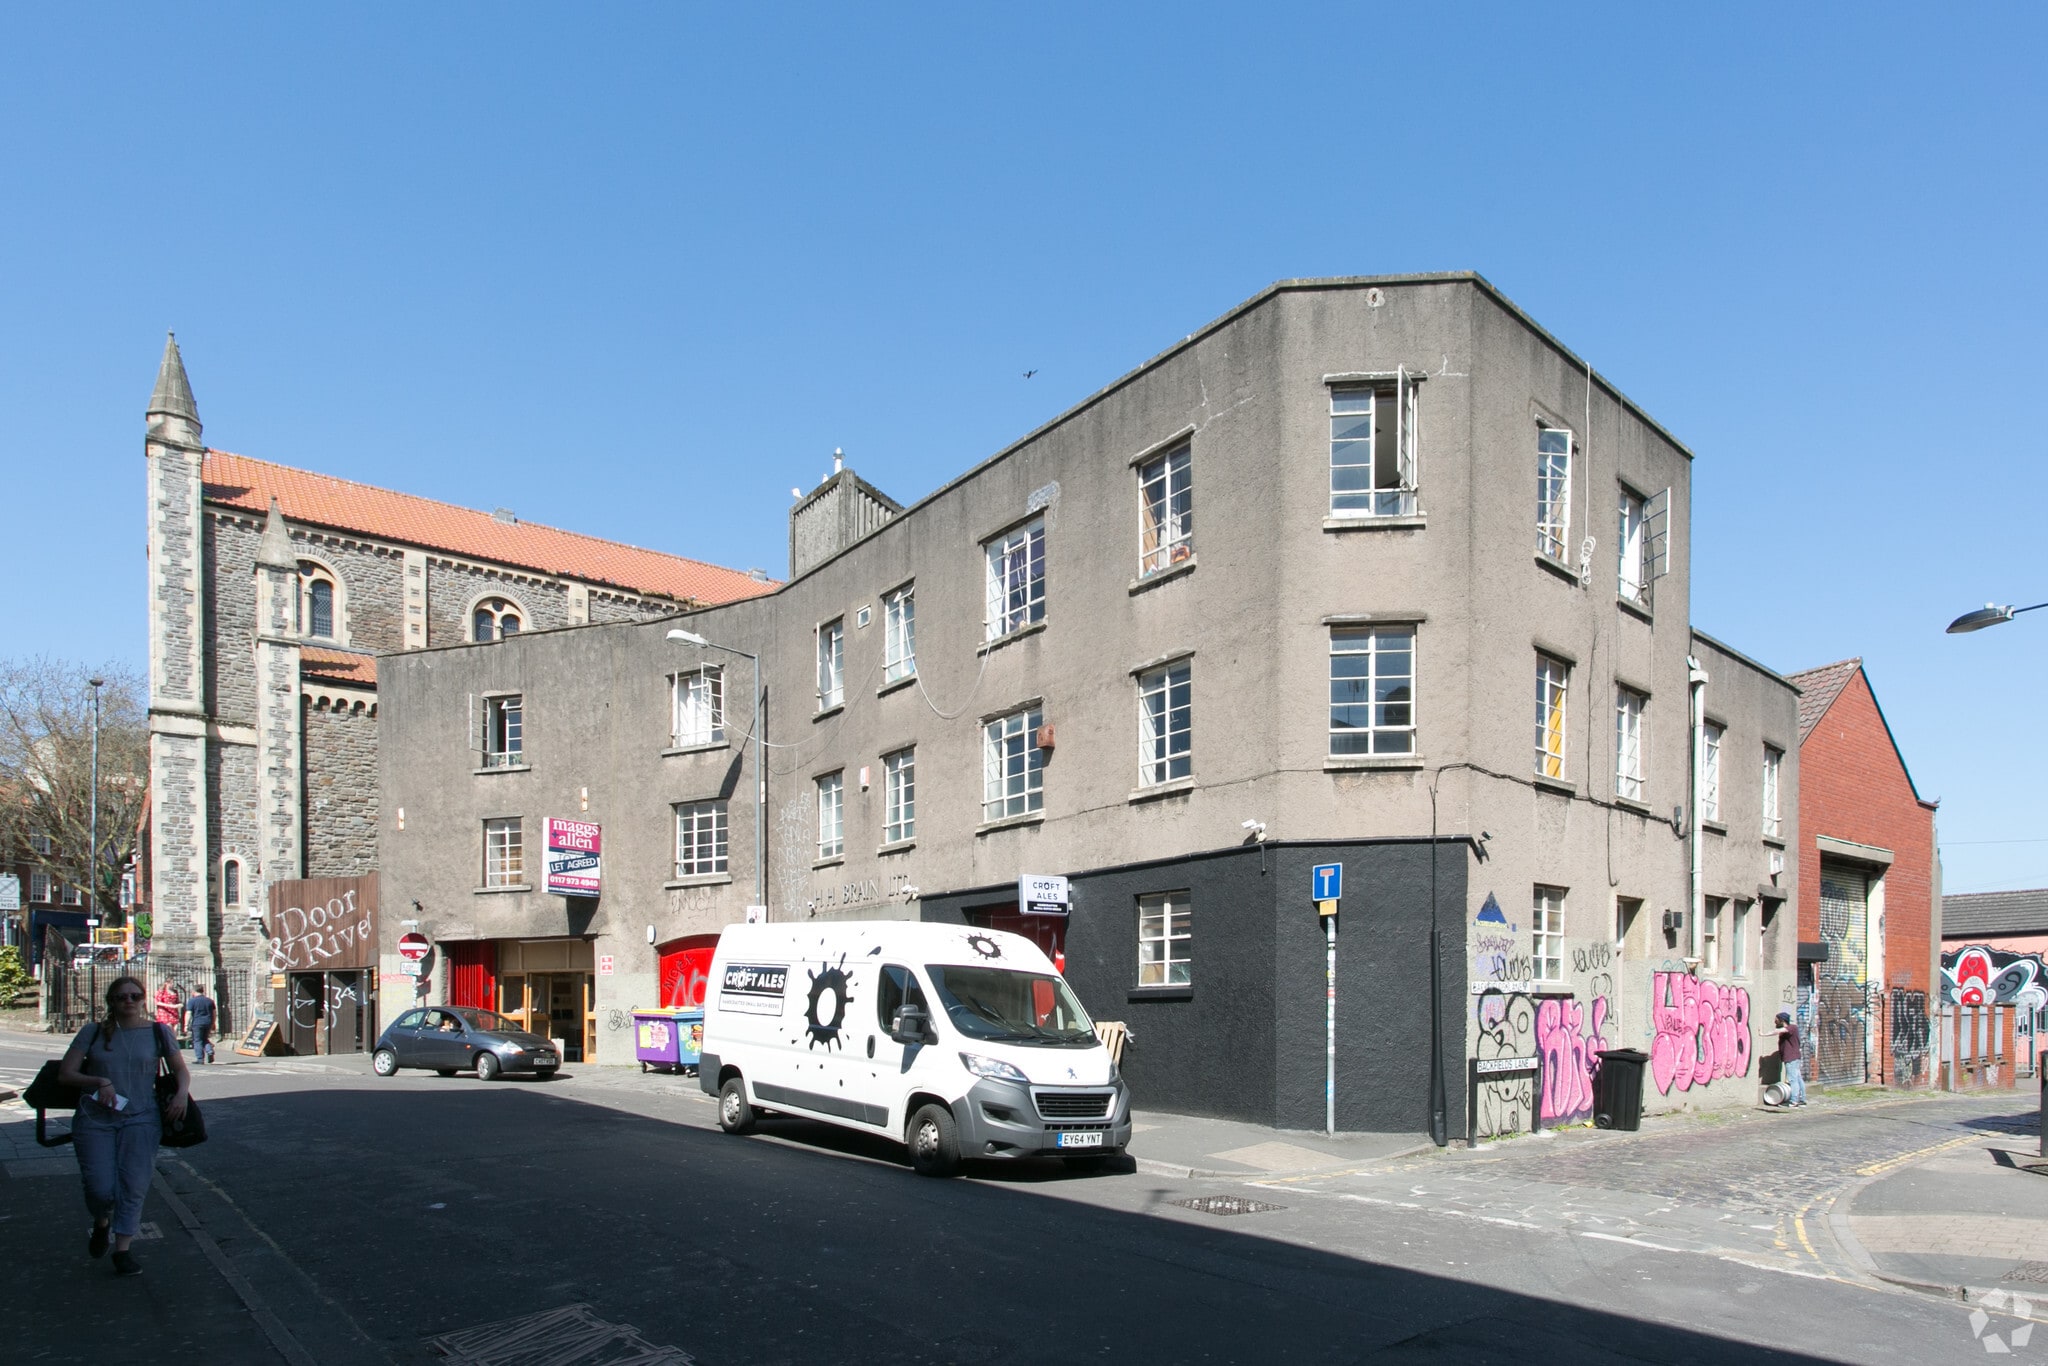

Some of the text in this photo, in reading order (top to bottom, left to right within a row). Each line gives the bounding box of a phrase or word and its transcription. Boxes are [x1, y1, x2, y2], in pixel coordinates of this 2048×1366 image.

[553, 820, 599, 838] maggs
[559, 833, 593, 849] allen
[550, 858, 596, 872] LET AGREED
[566, 877, 579, 885] 973
[1032, 881, 1060, 890] CROFT
[827, 888, 836, 906] H
[842, 877, 880, 905] BRAIN
[888, 874, 911, 897] LTD
[1036, 892, 1058, 900] ALES
[275, 889, 356, 945] Door
[269, 909, 373, 973] & River
[725, 971, 758, 988] CROFT
[757, 974, 785, 989] ALES
[1478, 1060, 1512, 1072] BACKFIELDS
[1515, 1058, 1529, 1068] LANE
[1064, 1135, 1084, 1144] EY64
[1087, 1134, 1101, 1143] YNT
